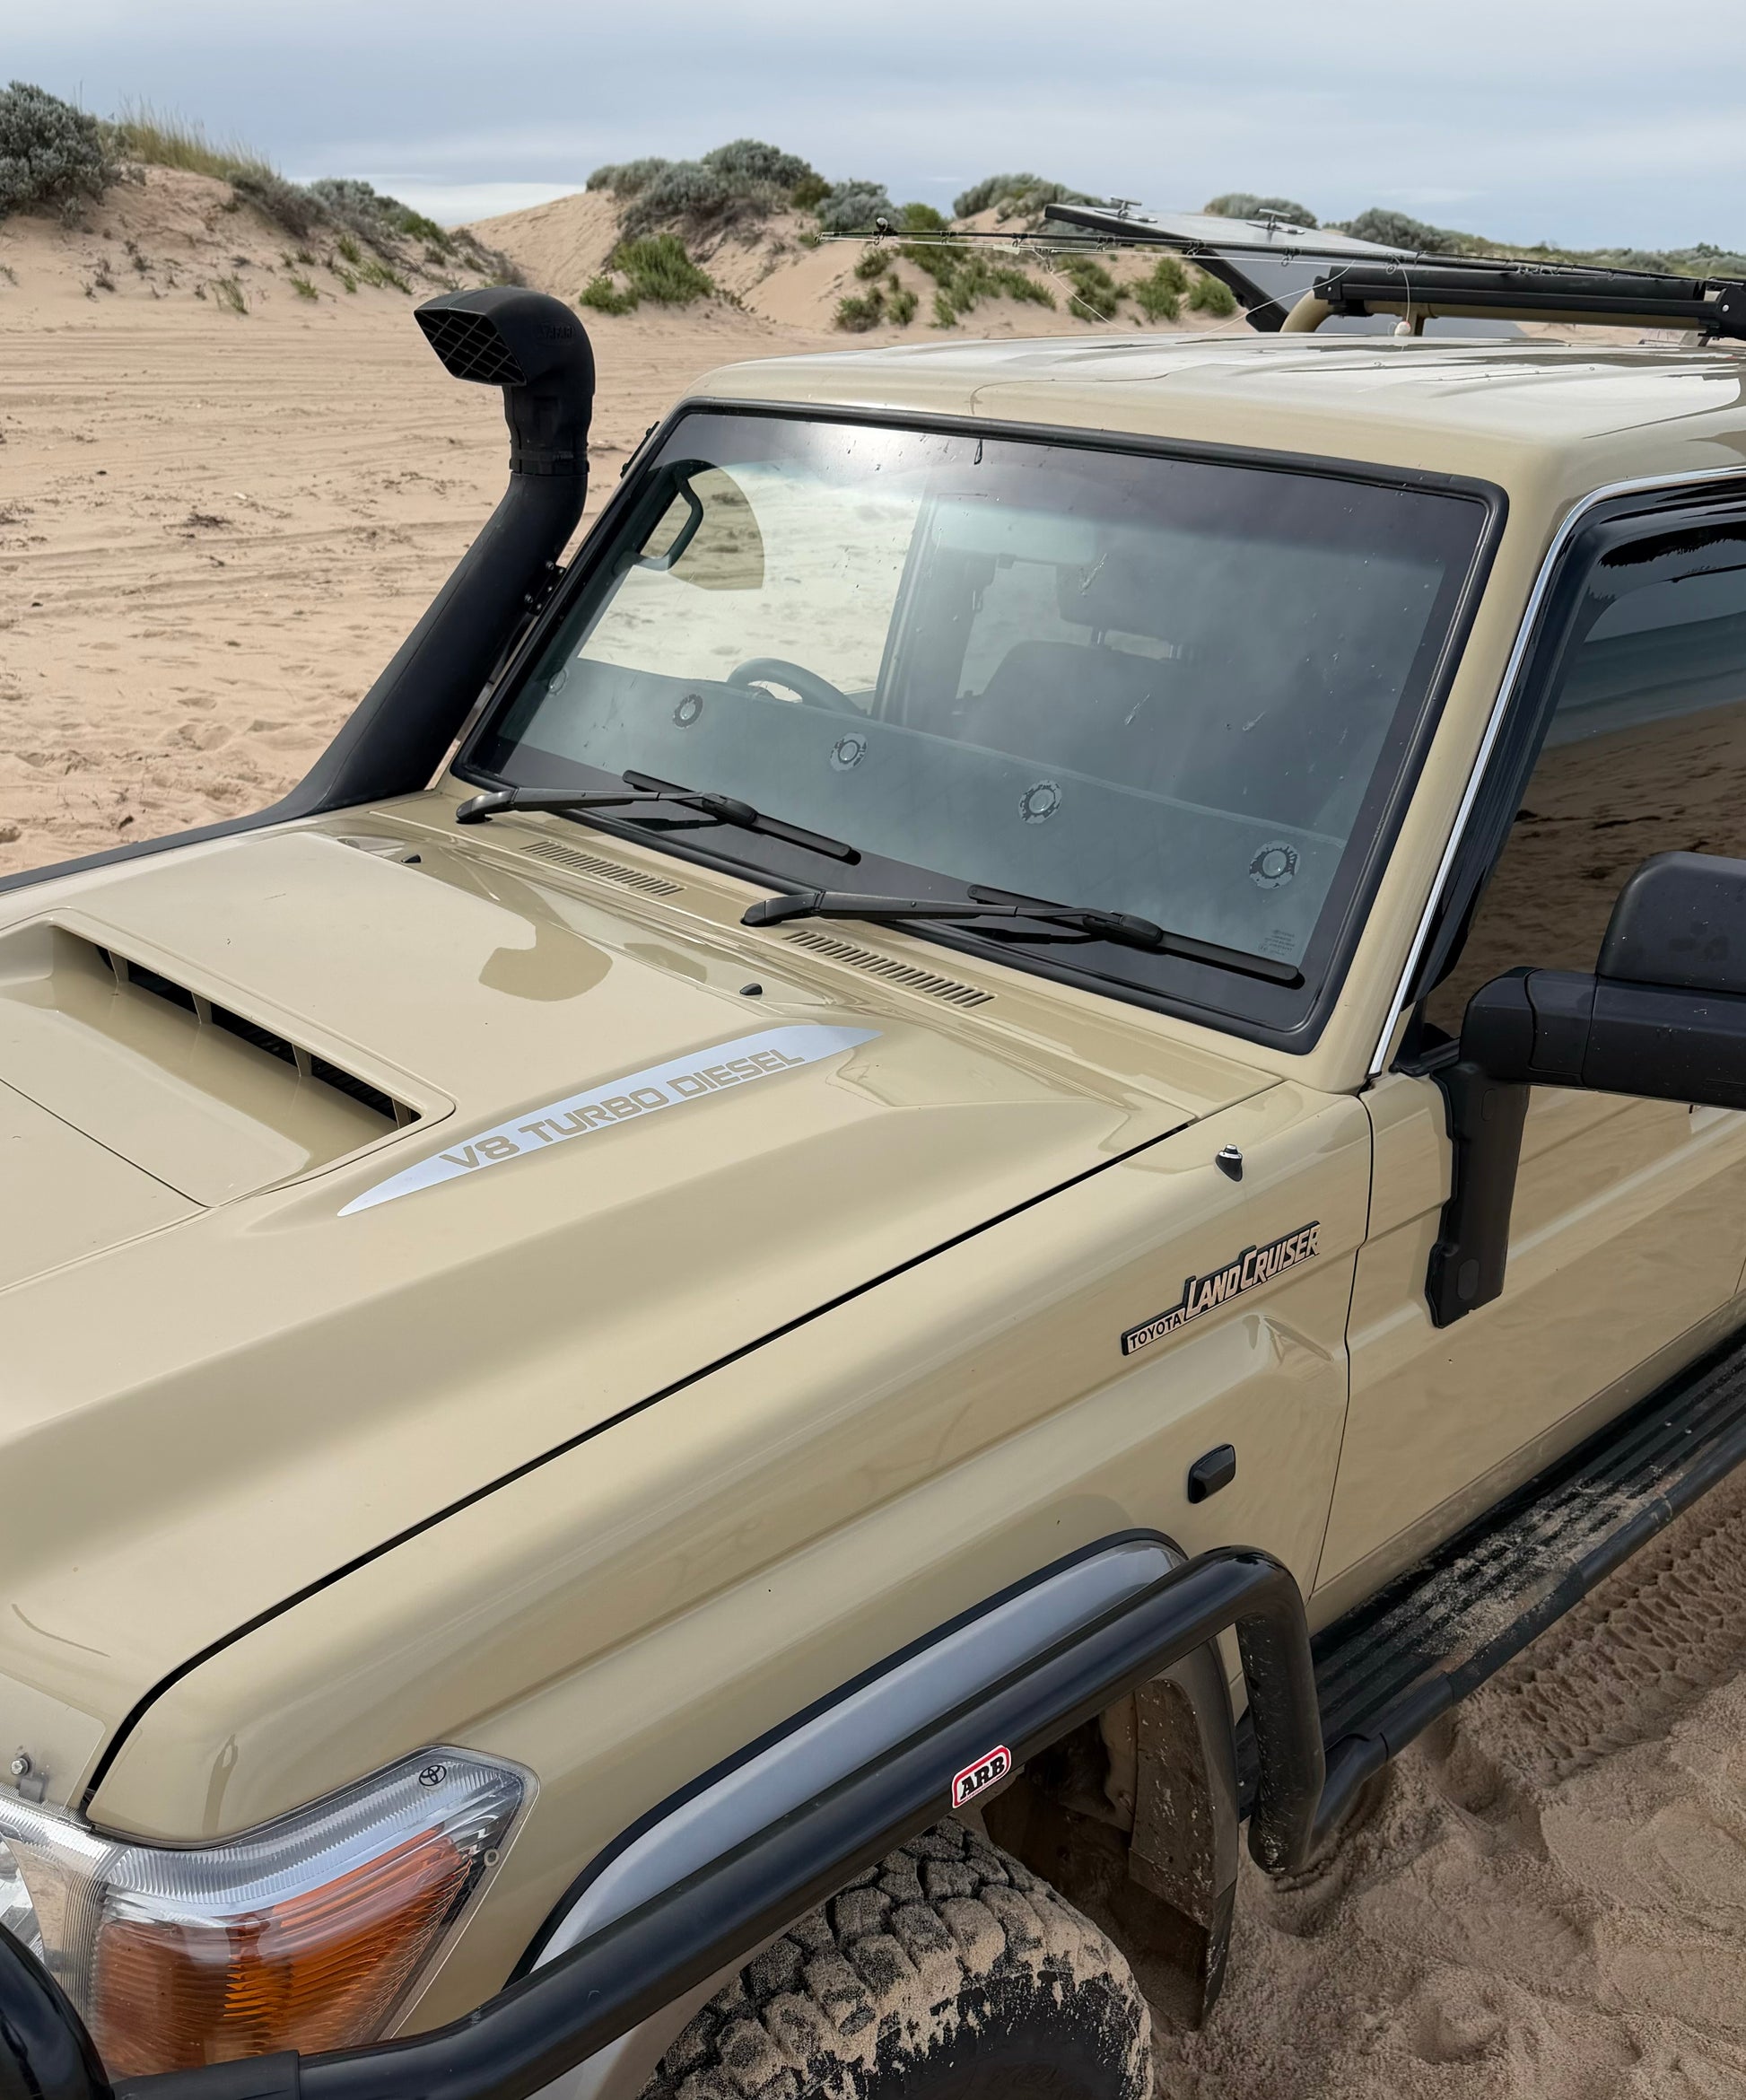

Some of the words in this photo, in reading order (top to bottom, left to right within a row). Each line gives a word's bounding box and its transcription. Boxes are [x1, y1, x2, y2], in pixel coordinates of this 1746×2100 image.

[440, 1135, 520, 1168] V8
[518, 1087, 669, 1143] TURBO
[666, 1048, 806, 1098] DIESEL
[1129, 1313, 1183, 1349] TOYOTA
[959, 1755, 1006, 1801] ARB
